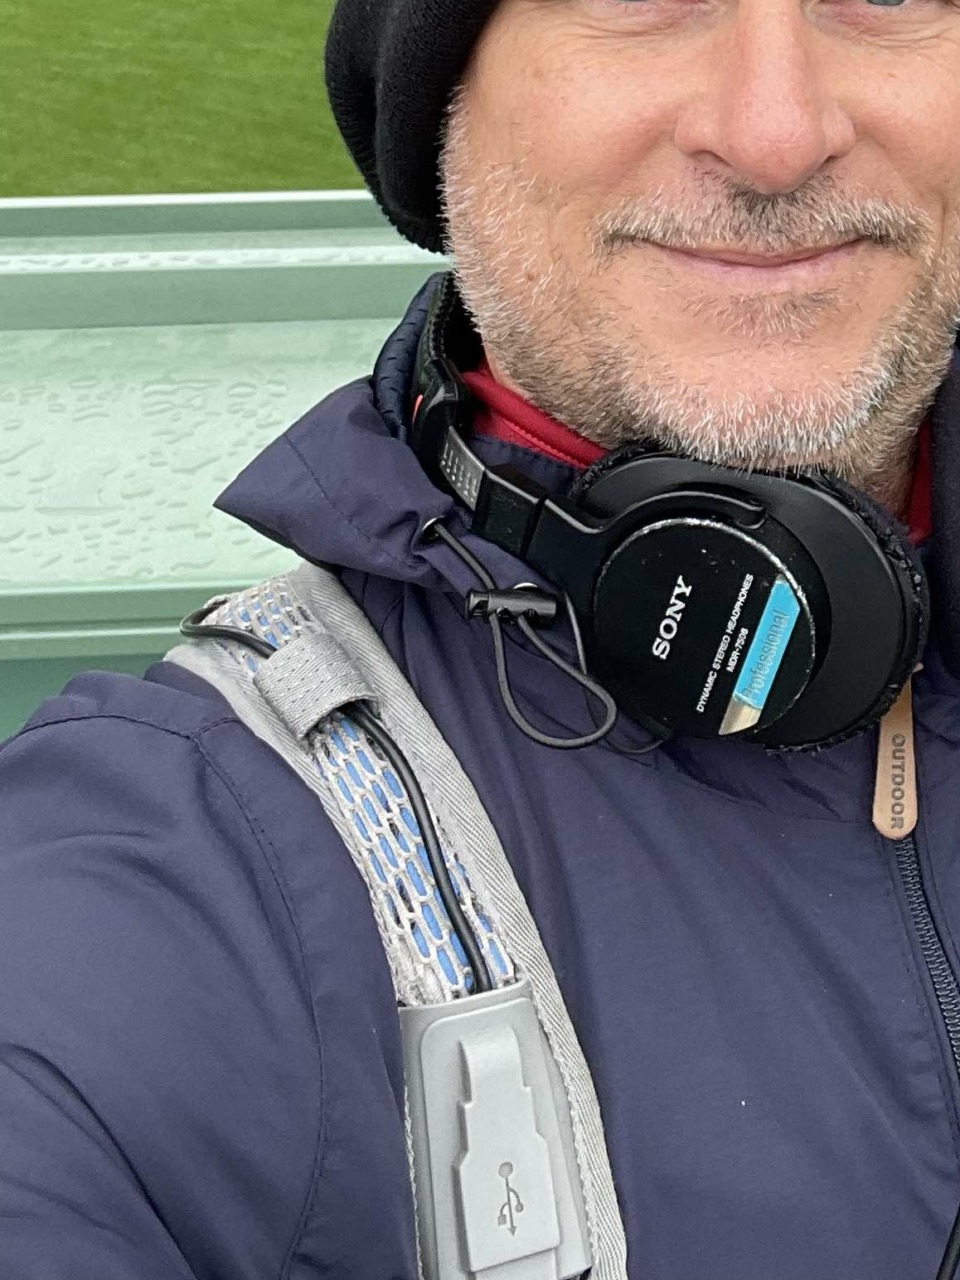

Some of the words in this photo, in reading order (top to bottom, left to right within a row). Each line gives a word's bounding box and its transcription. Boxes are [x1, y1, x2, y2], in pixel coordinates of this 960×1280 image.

[652, 575, 692, 660] SONY
[696, 670, 718, 713] DYNAMIC
[712, 634, 731, 671] STEREO
[726, 573, 754, 635] HEADPHONES
[891, 733, 906, 830] OUTDOOR
